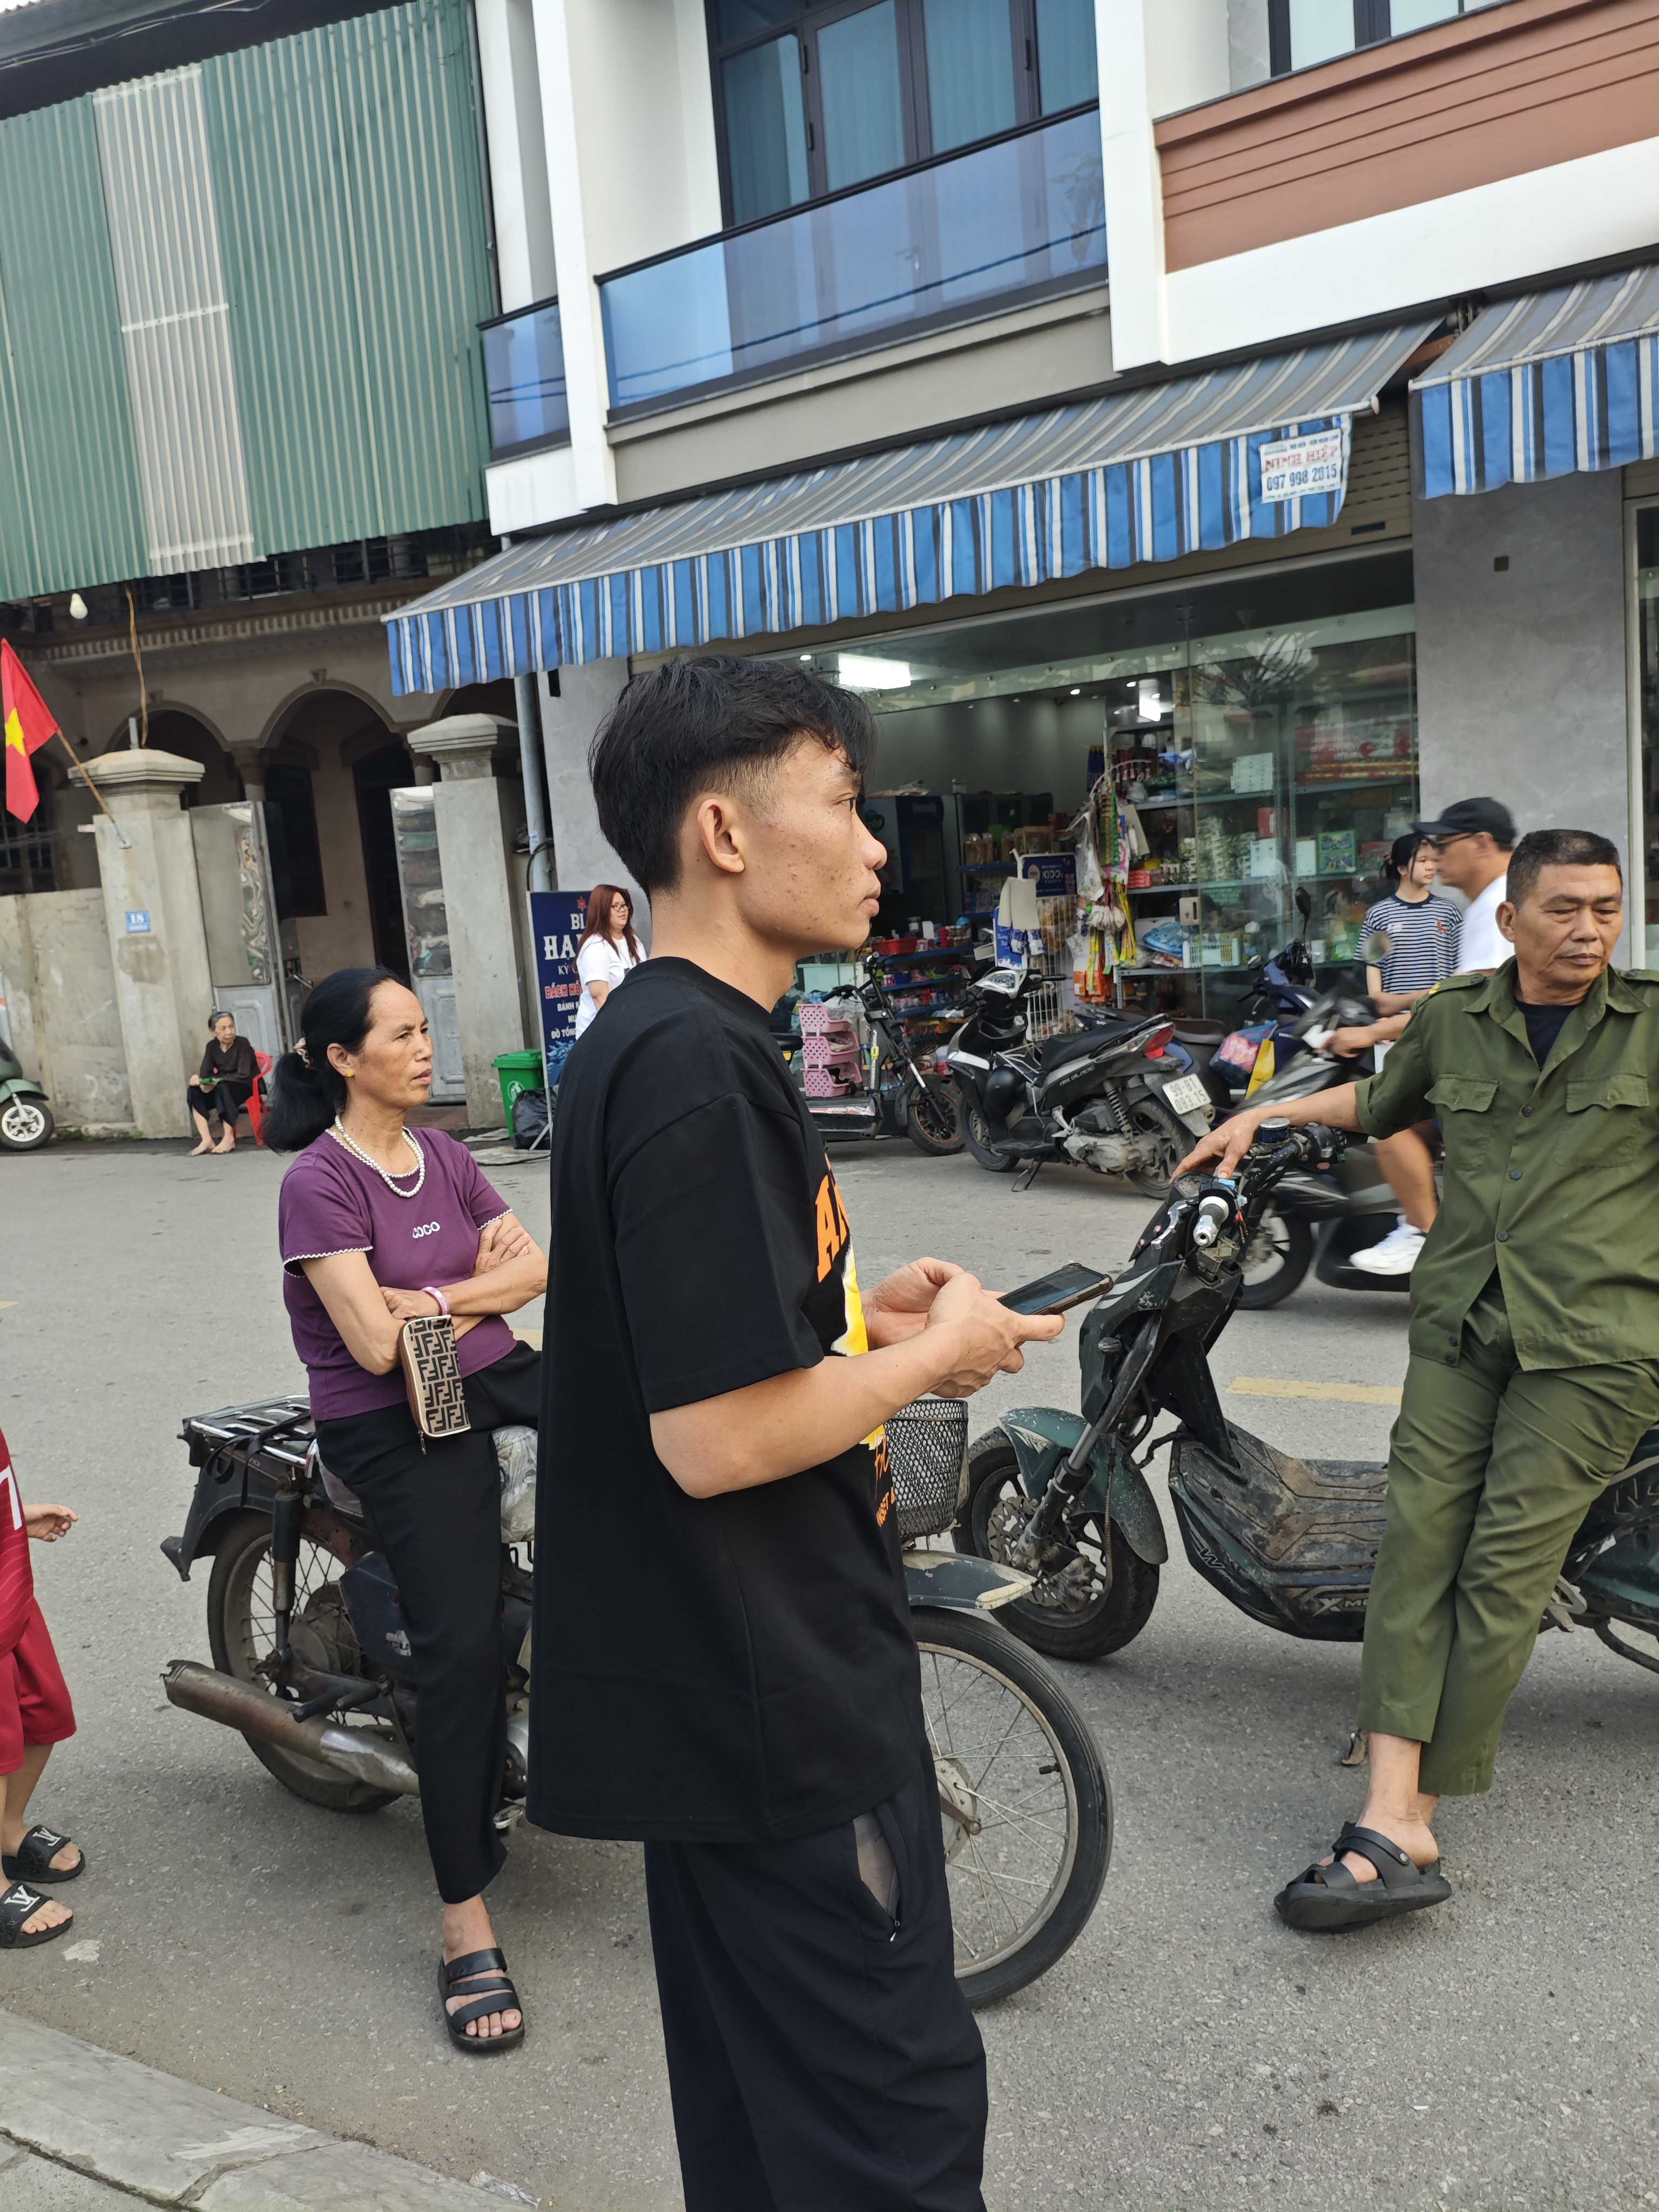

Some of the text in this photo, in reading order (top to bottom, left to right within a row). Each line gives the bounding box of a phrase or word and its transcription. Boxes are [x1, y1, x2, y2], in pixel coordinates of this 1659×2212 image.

[1266, 463, 1337, 491] 097 998 2015
[544, 982, 568, 999] BÁCH
[557, 1000, 575, 1011] BÁNH
[412, 1221, 441, 1239] COCO
